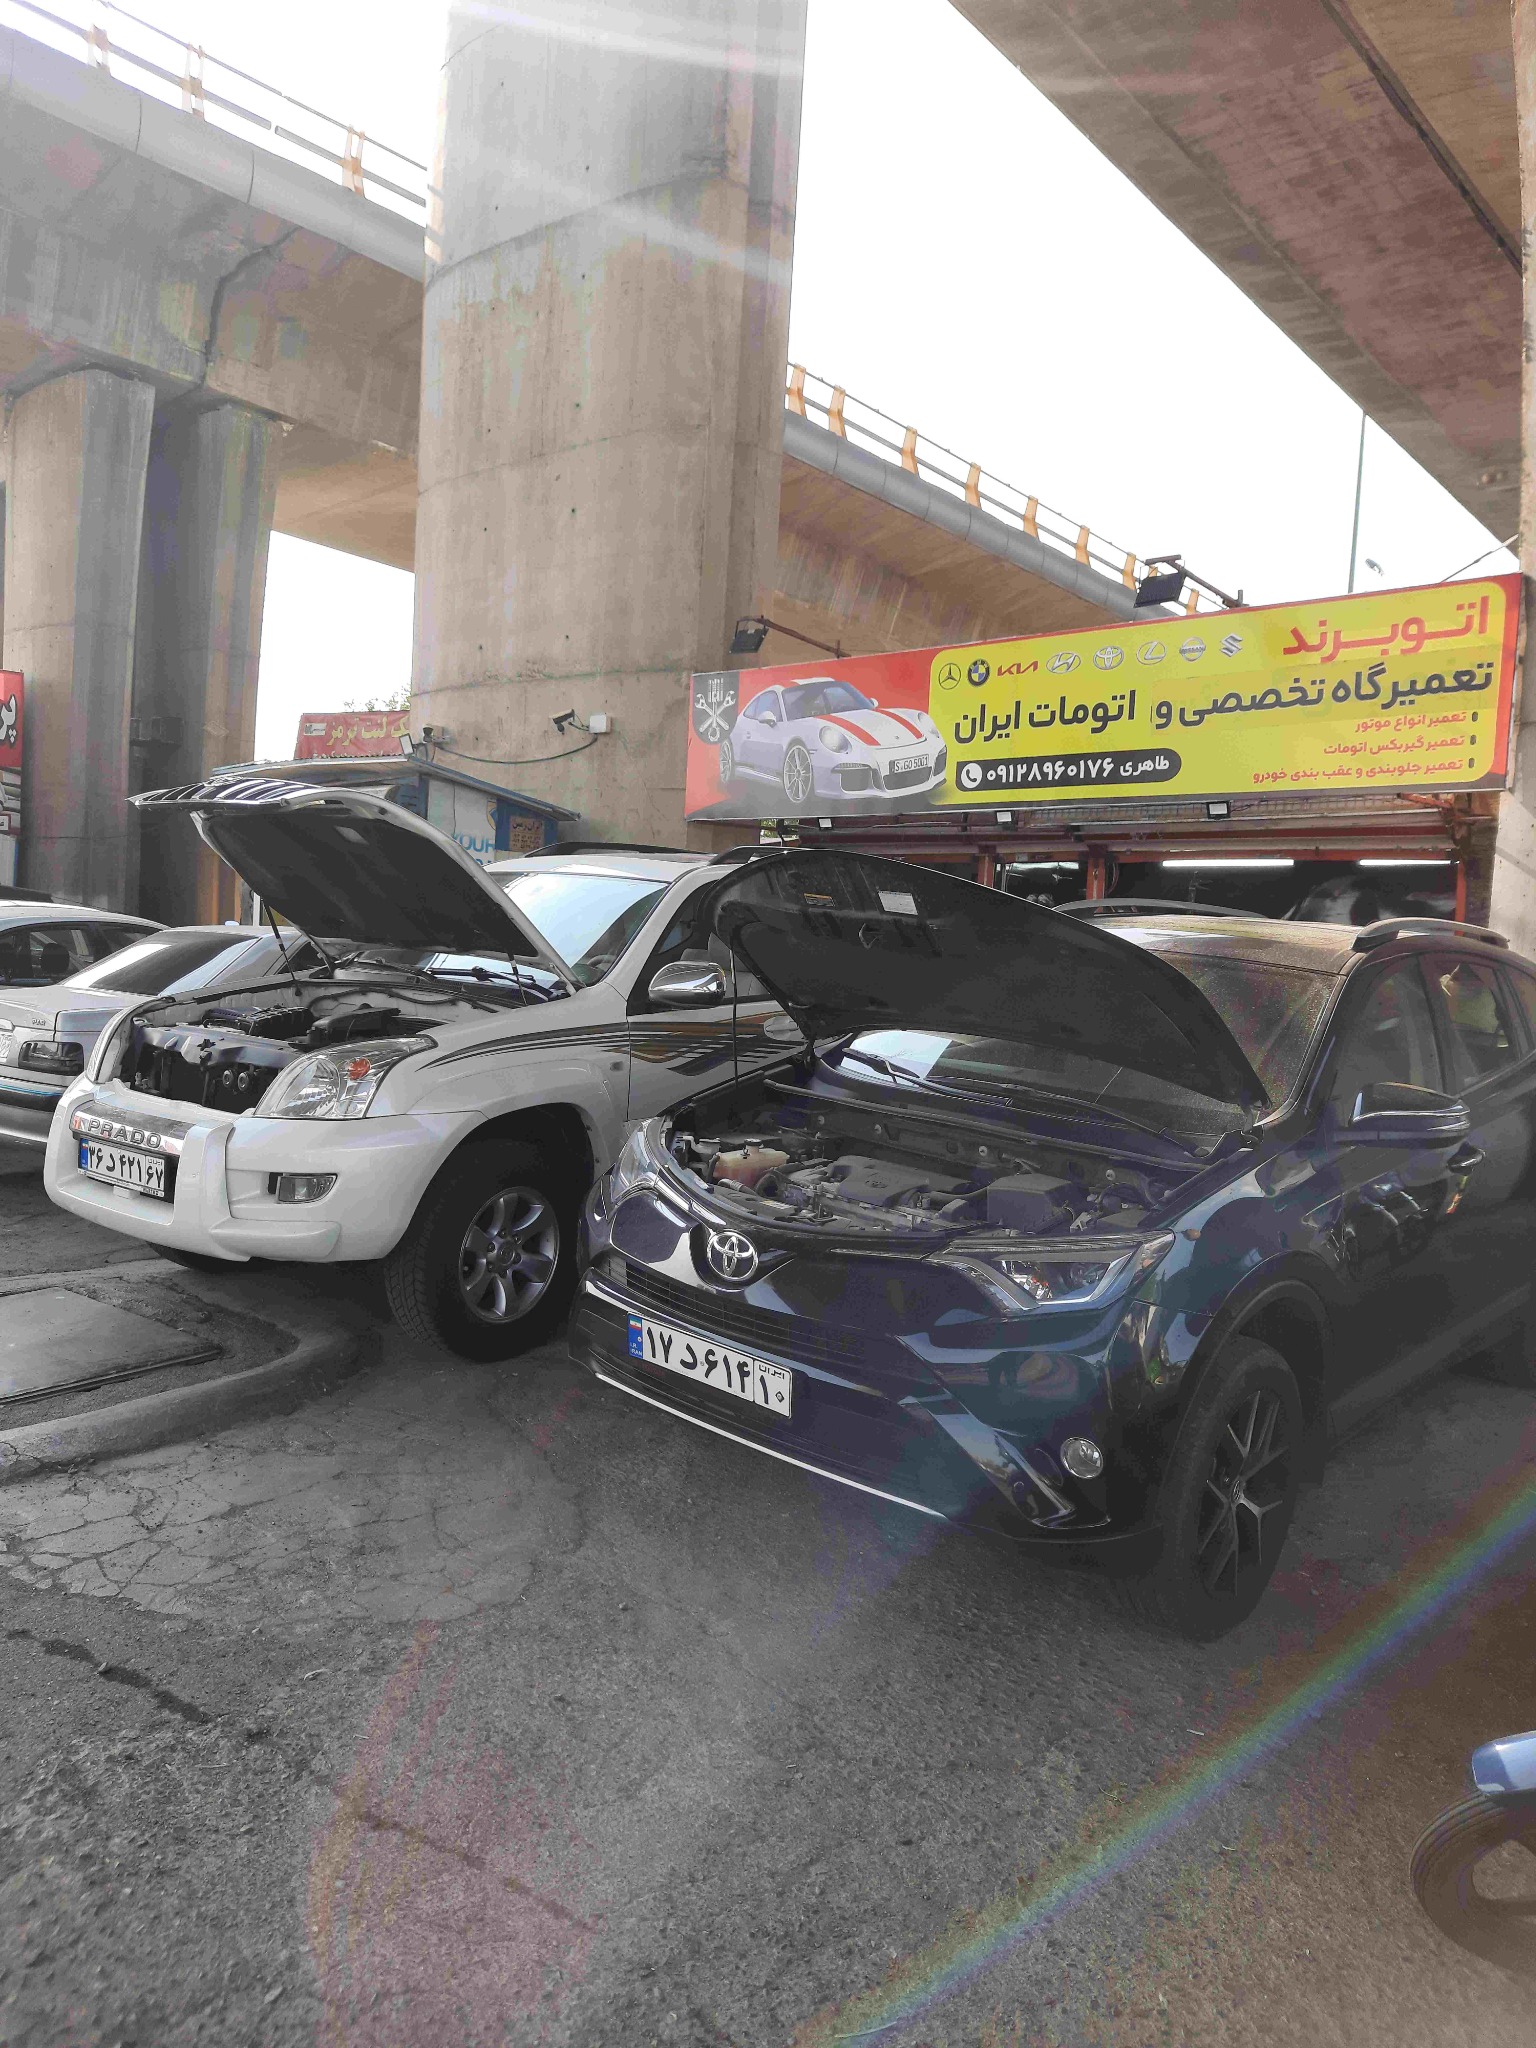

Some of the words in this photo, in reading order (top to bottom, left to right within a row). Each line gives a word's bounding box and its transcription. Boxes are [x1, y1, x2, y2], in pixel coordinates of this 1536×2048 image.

[1331, 662, 1495, 710] تعمیرگاه
[1028, 690, 1137, 734] اتومات
[1178, 677, 1326, 728] تخصصی
[954, 700, 1022, 744] ایران
[1155, 699, 1173, 730] و
[1393, 714, 1426, 732] انواع
[1427, 711, 1468, 728] تعمیر
[326, 717, 360, 746] ترمز
[361, 715, 388, 739] لنت
[1355, 718, 1392, 734] موتور
[1323, 741, 1368, 756] اتومات
[1369, 735, 1425, 755] گیربکس
[1426, 735, 1466, 752] تعمیر
[986, 756, 1115, 783] ۰۹۱۲۸۹۶۰۱۷۶
[1119, 755, 1170, 778] طاهری
[1253, 768, 1287, 784] خودرو
[1290, 769, 1319, 782] بندی
[1322, 767, 1353, 779] عقب
[1355, 768, 1363, 779] و
[1365, 763, 1422, 779] جلوبندی
[1423, 759, 1464, 775] تعمیر
[87, 1117, 162, 1149] PRADO
[758, 1363, 785, 1380] ایران
[759, 1374, 785, 1405] ۱۰
